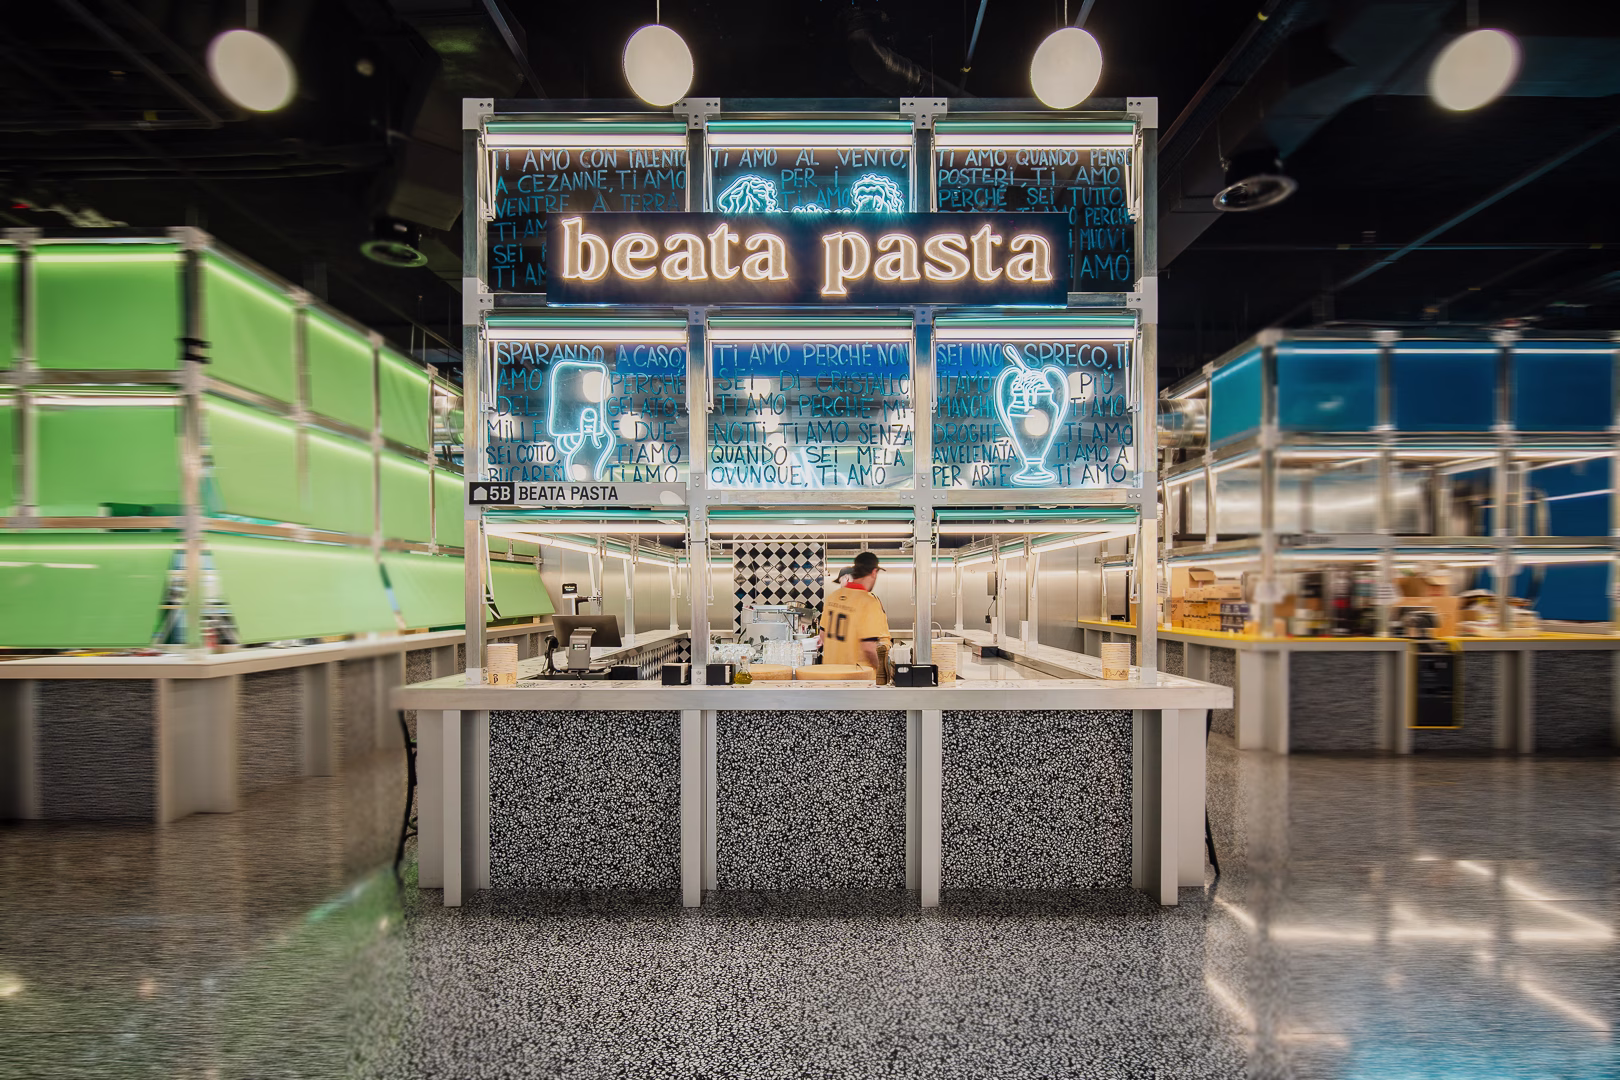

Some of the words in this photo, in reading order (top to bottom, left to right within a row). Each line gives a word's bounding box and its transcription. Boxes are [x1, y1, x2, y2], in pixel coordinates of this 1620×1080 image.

[522, 148, 570, 172] AMO
[579, 148, 617, 168] CON
[739, 148, 778, 168] AMO
[796, 149, 819, 167] AL
[965, 149, 1007, 167] AMO
[1016, 149, 1079, 167] QUANDO
[495, 175, 508, 197] A
[517, 170, 613, 194] CEZANNE,
[644, 170, 686, 190] AMO
[781, 169, 818, 189] PER
[1075, 166, 1121, 186] AMO
[620, 194, 681, 213] TERRA
[816, 187, 851, 208] AMO
[523, 218, 548, 239] AM
[561, 216, 789, 281] beata
[821, 224, 1053, 296] pasta
[1080, 253, 1131, 282] AMO
[525, 262, 548, 286] AM
[497, 341, 604, 365] SPARANDO
[617, 344, 631, 367] A
[749, 342, 790, 366] AMO
[803, 341, 873, 367] PERCHÉ
[876, 343, 911, 367] NON
[971, 343, 1003, 368] UNO
[498, 367, 543, 392] AMO
[609, 369, 685, 395] PERCHÉ
[955, 370, 993, 395] AMO
[498, 395, 538, 417] DEL
[745, 391, 787, 416] AMO
[1091, 394, 1125, 418] AMO
[634, 420, 677, 442] DUE
[805, 420, 849, 444] AMO
[857, 422, 913, 446] SENZA
[1092, 422, 1133, 446] AMO
[636, 443, 681, 465] AMO
[711, 445, 788, 466] QUANDO
[857, 446, 906, 467] MELA
[1073, 443, 1110, 463] AMO
[1115, 444, 1129, 464] A
[633, 464, 678, 483] AMO
[847, 464, 886, 486] AMO
[932, 464, 962, 487] PER
[1080, 463, 1127, 485] AMO
[489, 485, 512, 501] 5B
[518, 486, 565, 501] BEATA
[570, 486, 618, 501] PASTA
[827, 610, 849, 642] 10
